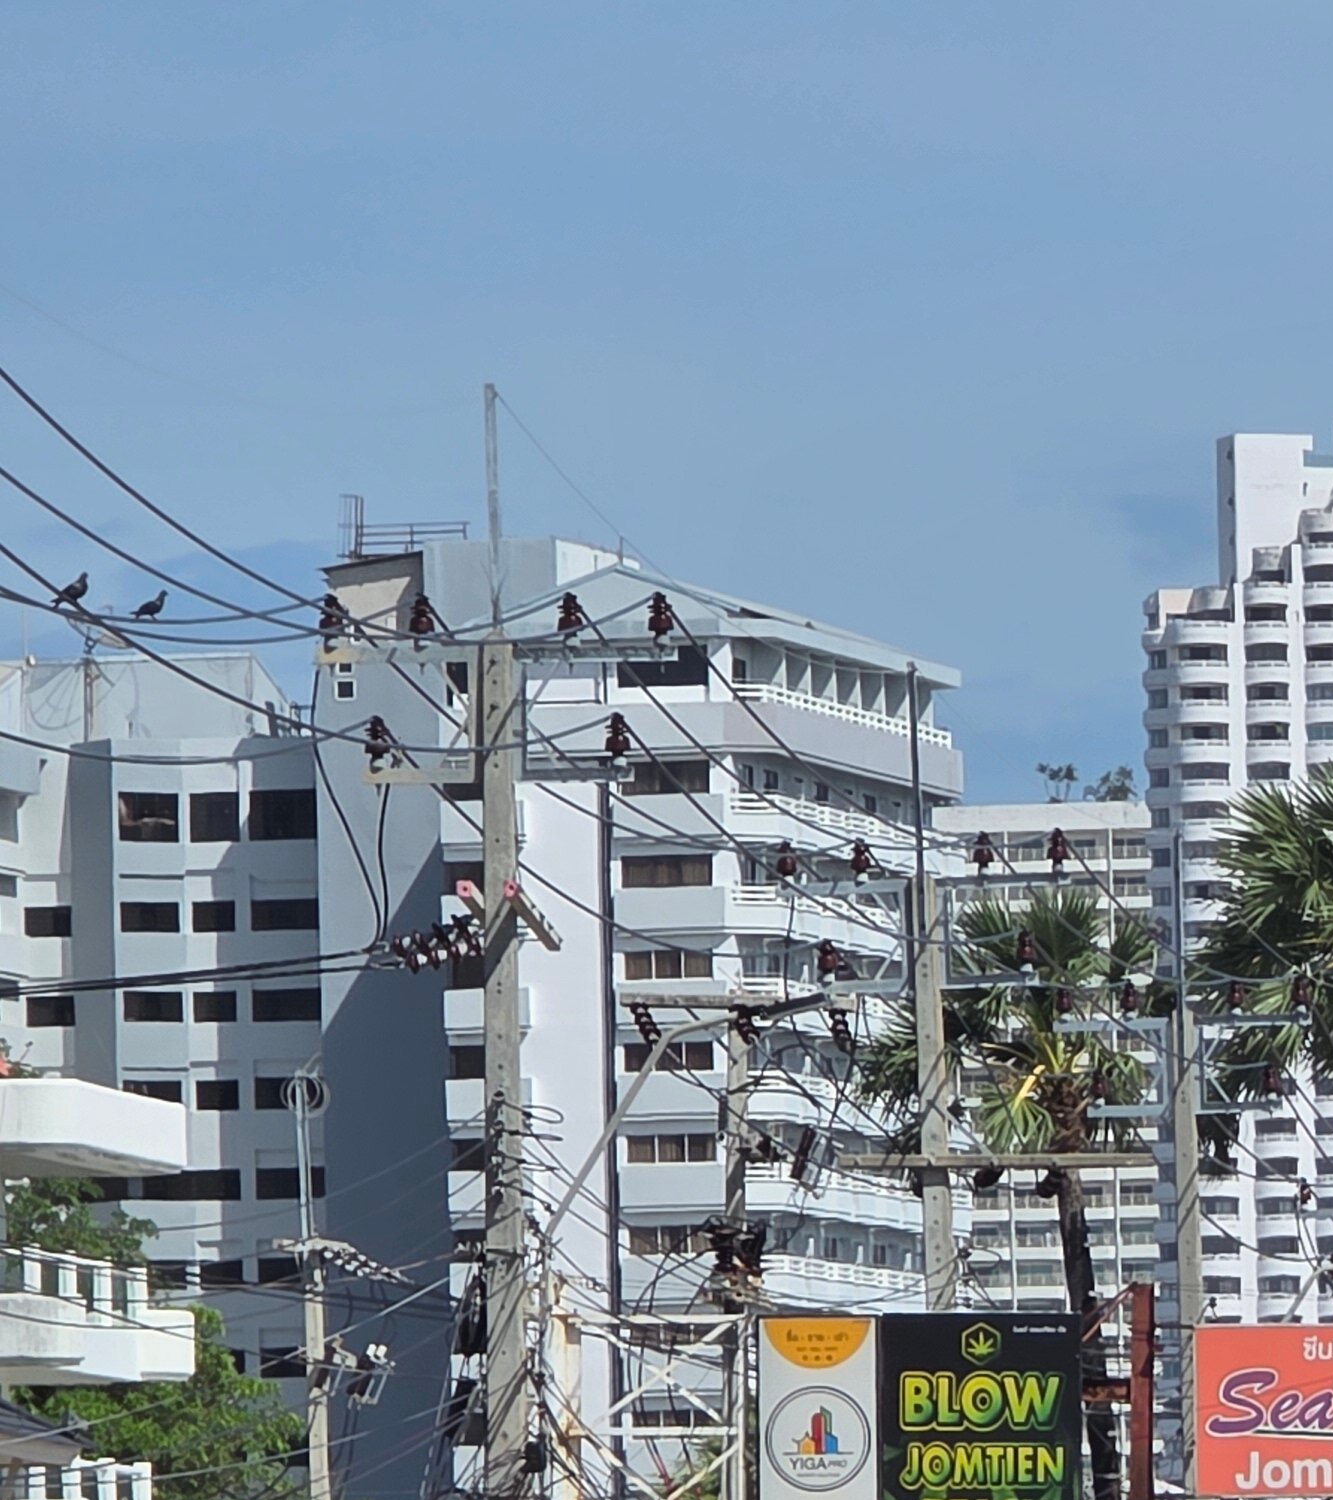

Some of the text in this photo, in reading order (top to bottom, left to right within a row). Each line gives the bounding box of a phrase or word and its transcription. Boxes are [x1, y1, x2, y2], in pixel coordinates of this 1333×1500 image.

[902, 1373, 1062, 1429] BLOW
[789, 1457, 827, 1470] YIGA
[903, 1444, 1064, 1487] JOMTIEN
